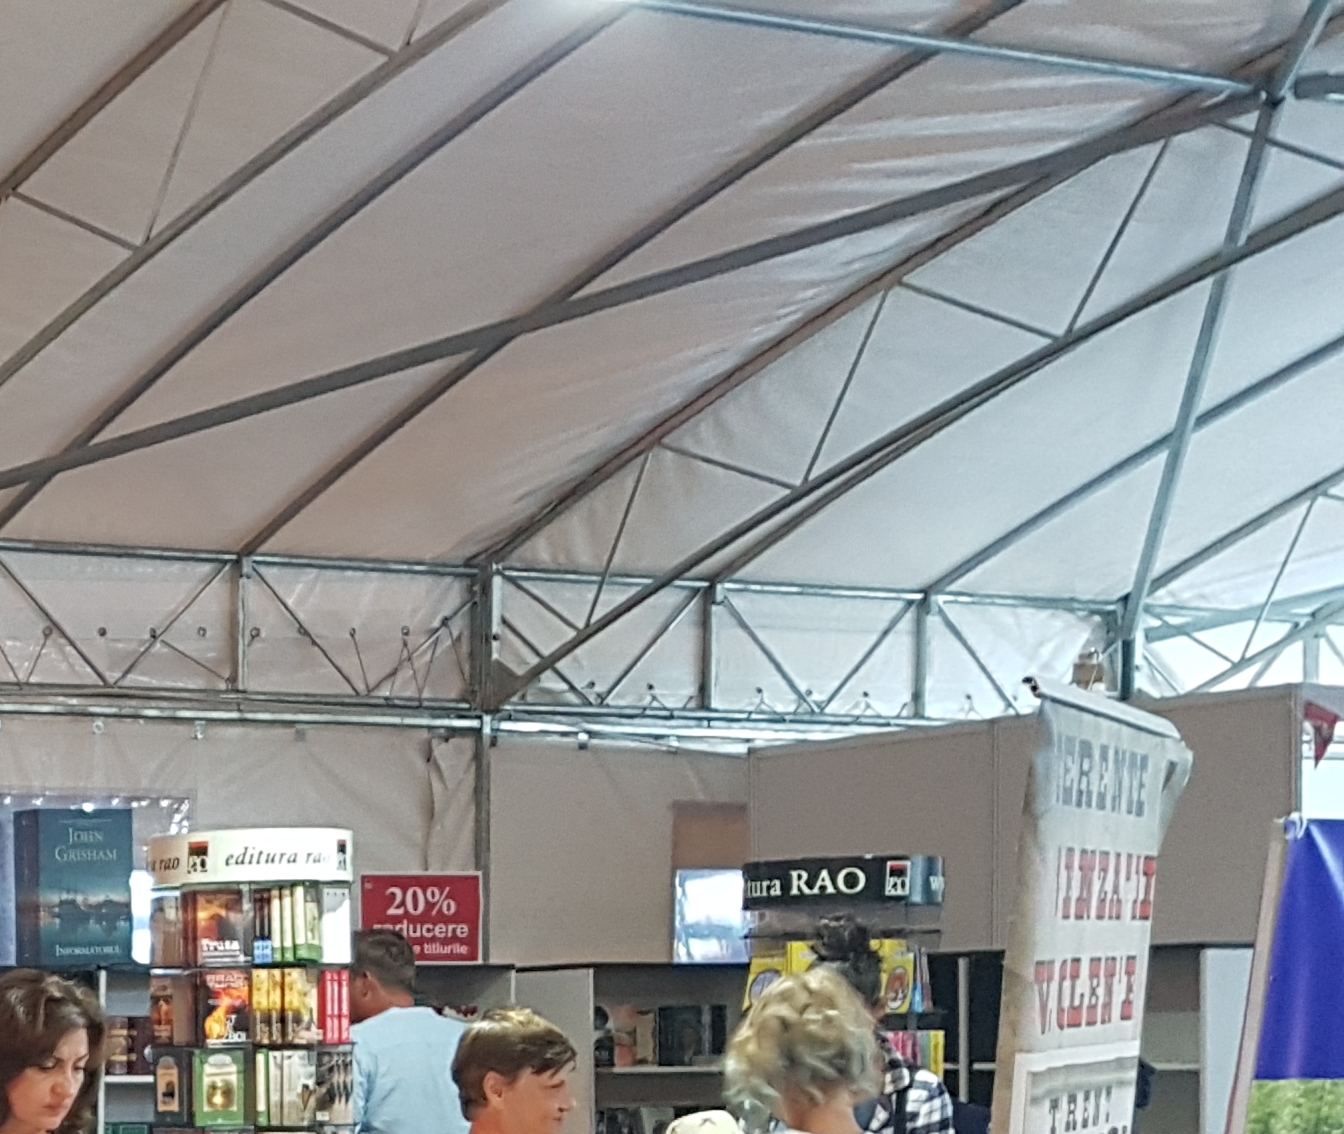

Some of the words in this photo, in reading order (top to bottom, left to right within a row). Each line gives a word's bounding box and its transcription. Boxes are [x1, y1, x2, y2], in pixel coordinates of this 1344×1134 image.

[1056, 733, 1150, 818] ERENTE
[67, 826, 105, 846] JOHN
[54, 844, 118, 862] GRISHAM
[225, 845, 298, 867] editura
[789, 866, 866, 896] RAO
[385, 886, 457, 916] 20%
[372, 919, 469, 938] ducere
